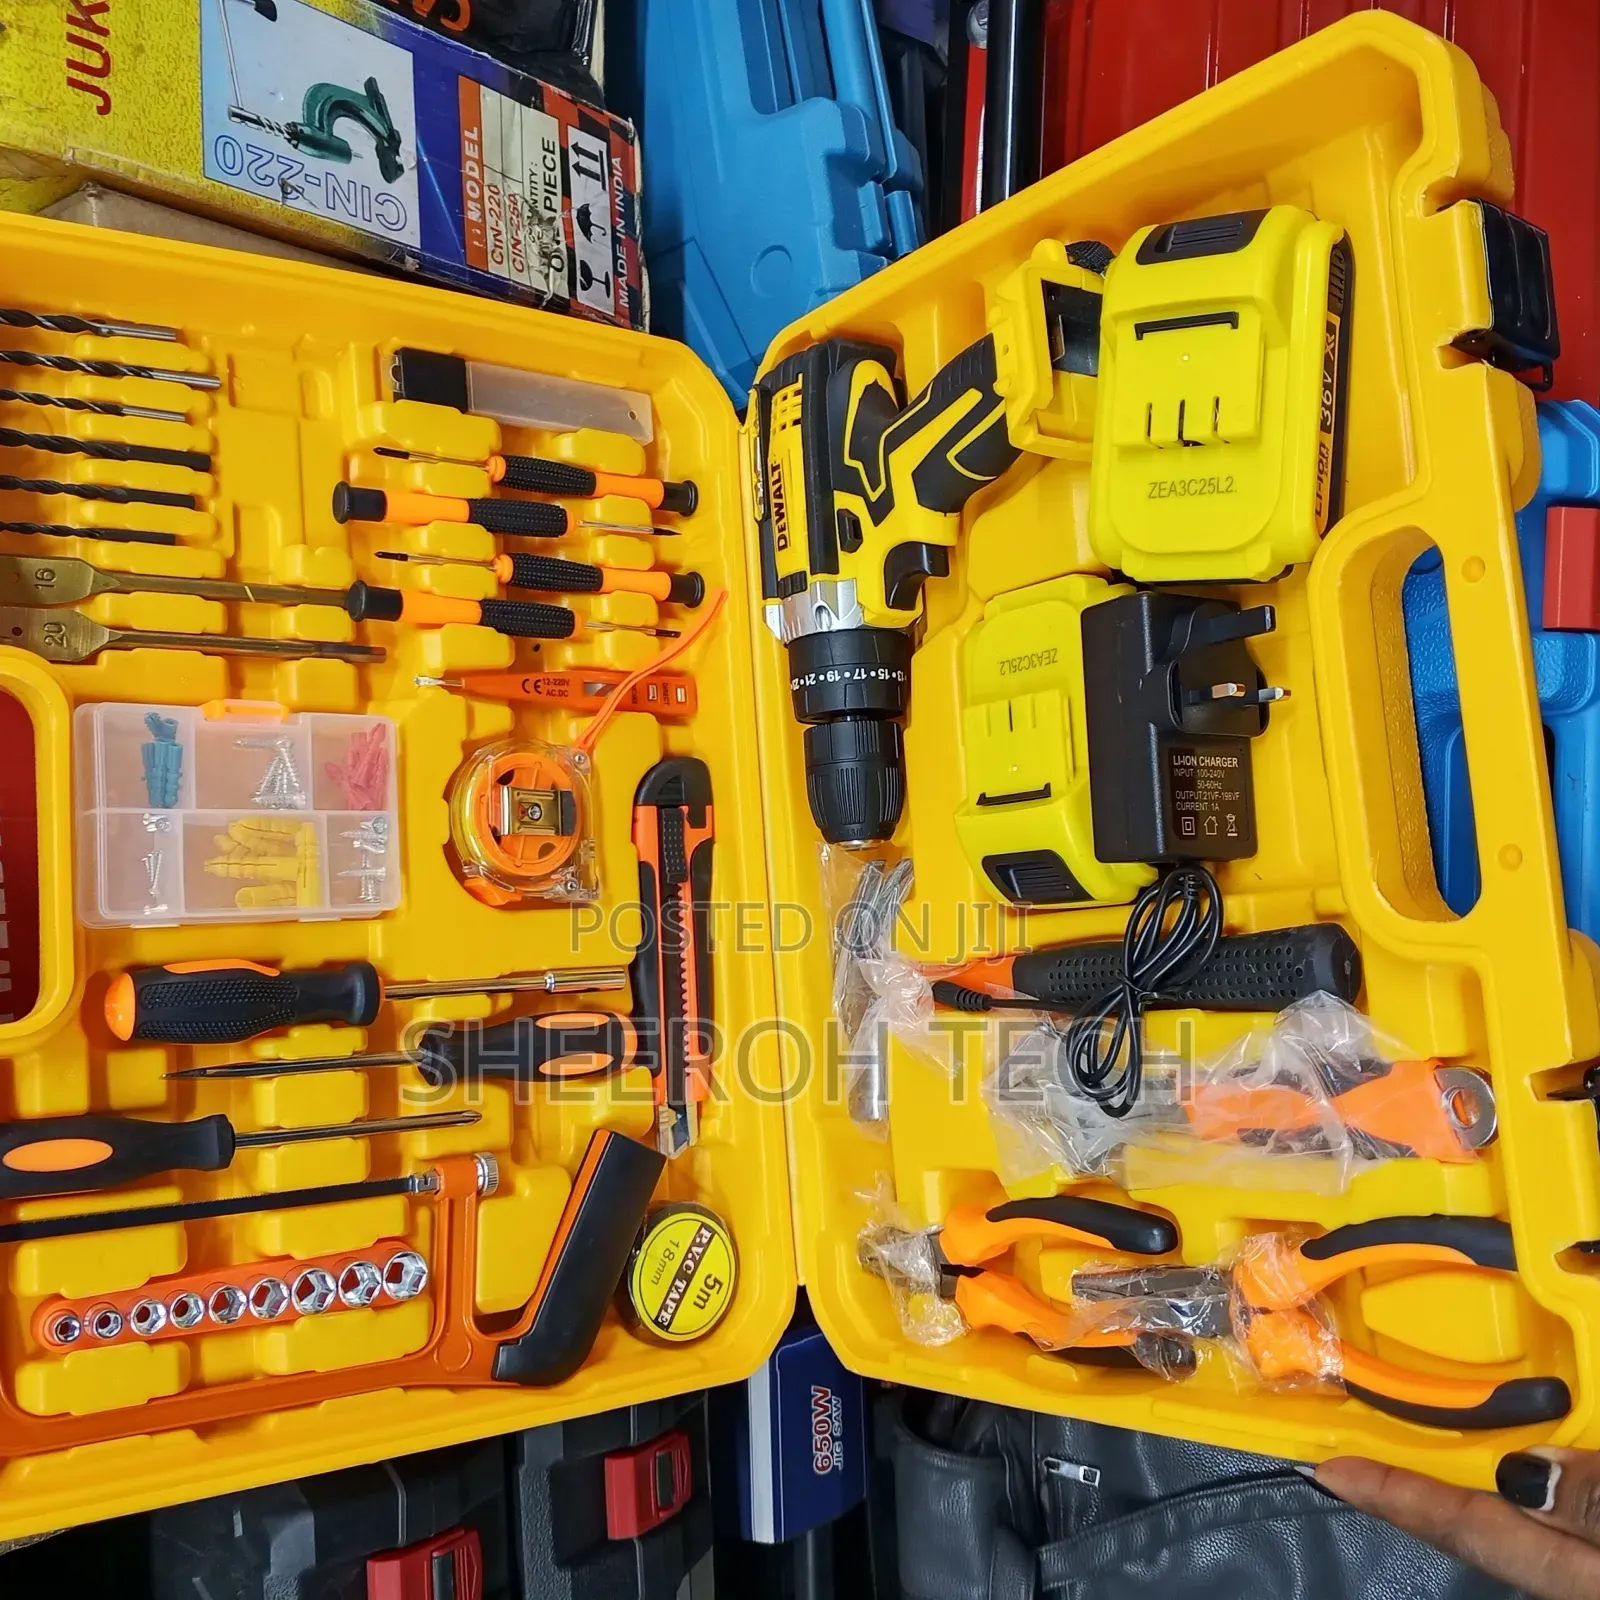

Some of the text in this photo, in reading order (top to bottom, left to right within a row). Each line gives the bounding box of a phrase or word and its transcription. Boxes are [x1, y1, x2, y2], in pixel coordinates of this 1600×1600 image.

[214, 135, 407, 231] CIN-220
[464, 126, 482, 223] MODEL
[542, 137, 558, 213] PIECE
[487, 184, 504, 265] CIN-220
[611, 157, 629, 307] MADE IN INDIA
[771, 463, 788, 552] DEWALT
[34, 568, 56, 590] 16
[44, 621, 66, 648] 20
[804, 673, 816, 686] 21
[826, 670, 841, 682] 19
[853, 668, 867, 679] 17
[877, 669, 890, 680] 15
[1199, 756, 1238, 768] CHARGER
[1211, 803, 1220, 811] 1A
[657, 1278, 687, 1326] TAPE
[693, 1273, 723, 1310] 5m
[811, 1385, 833, 1475] 650W
[832, 1395, 844, 1471] JIG SAW
